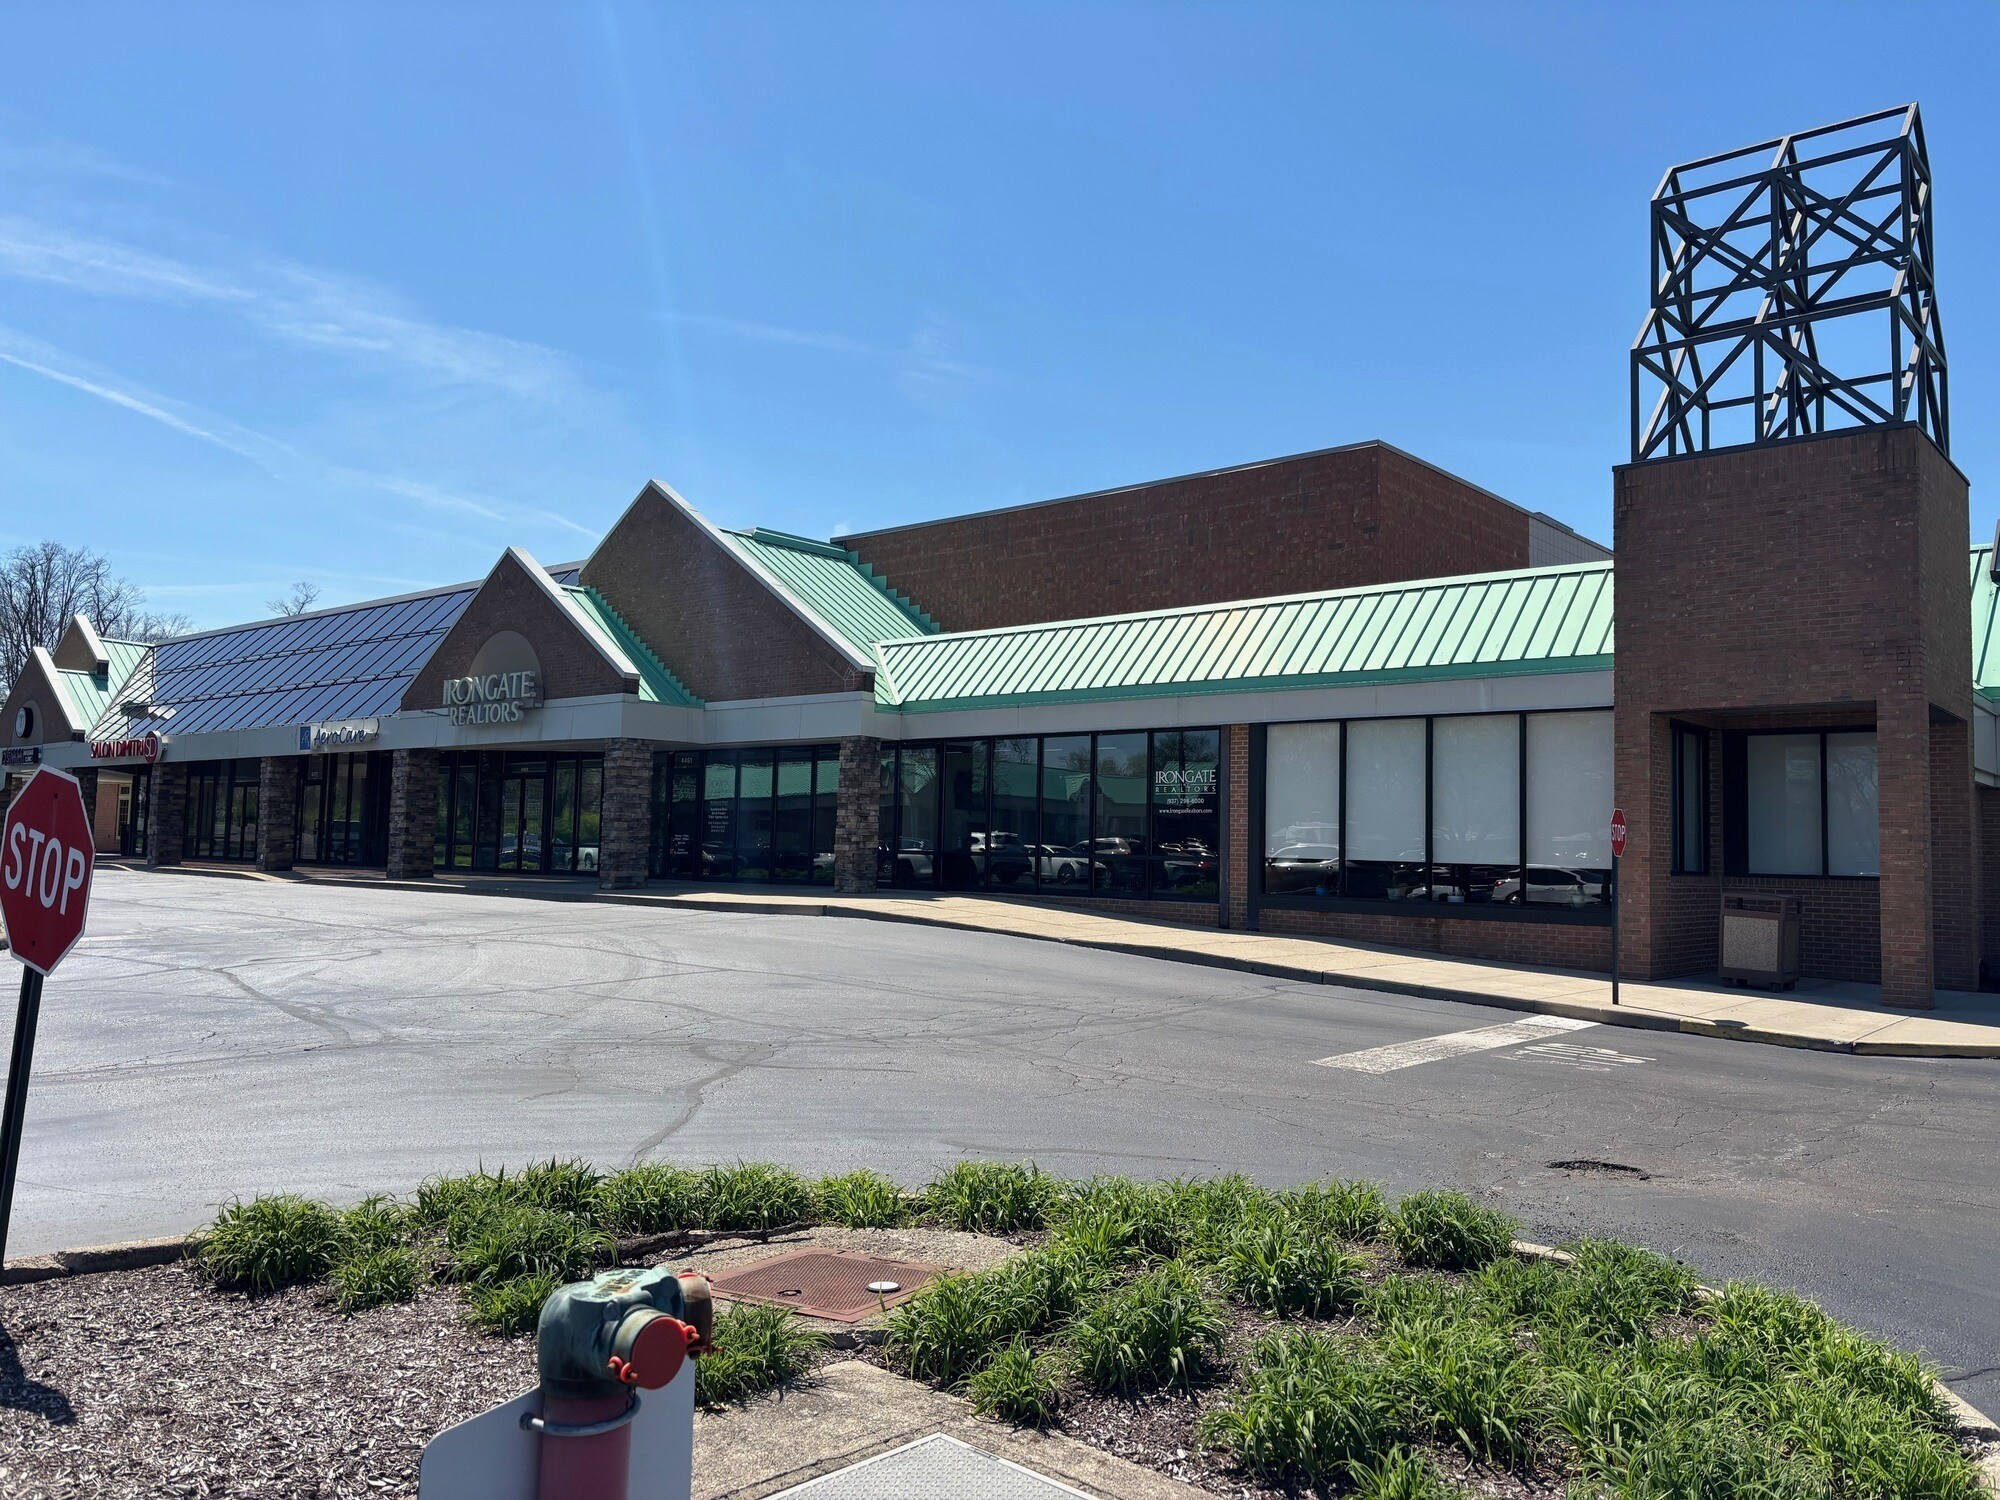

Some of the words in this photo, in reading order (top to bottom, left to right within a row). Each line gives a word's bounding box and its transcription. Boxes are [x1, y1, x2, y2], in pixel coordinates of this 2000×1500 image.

[442, 671, 536, 705] IRONGATE
[449, 701, 521, 726] REALTORS
[313, 726, 367, 746] AeroCare
[90, 740, 116, 759] SALON
[116, 739, 145, 758] DIMITRI
[1155, 770, 1217, 783] IRONGATE
[1611, 823, 1626, 842] STOP
[4, 821, 86, 916] STOP
